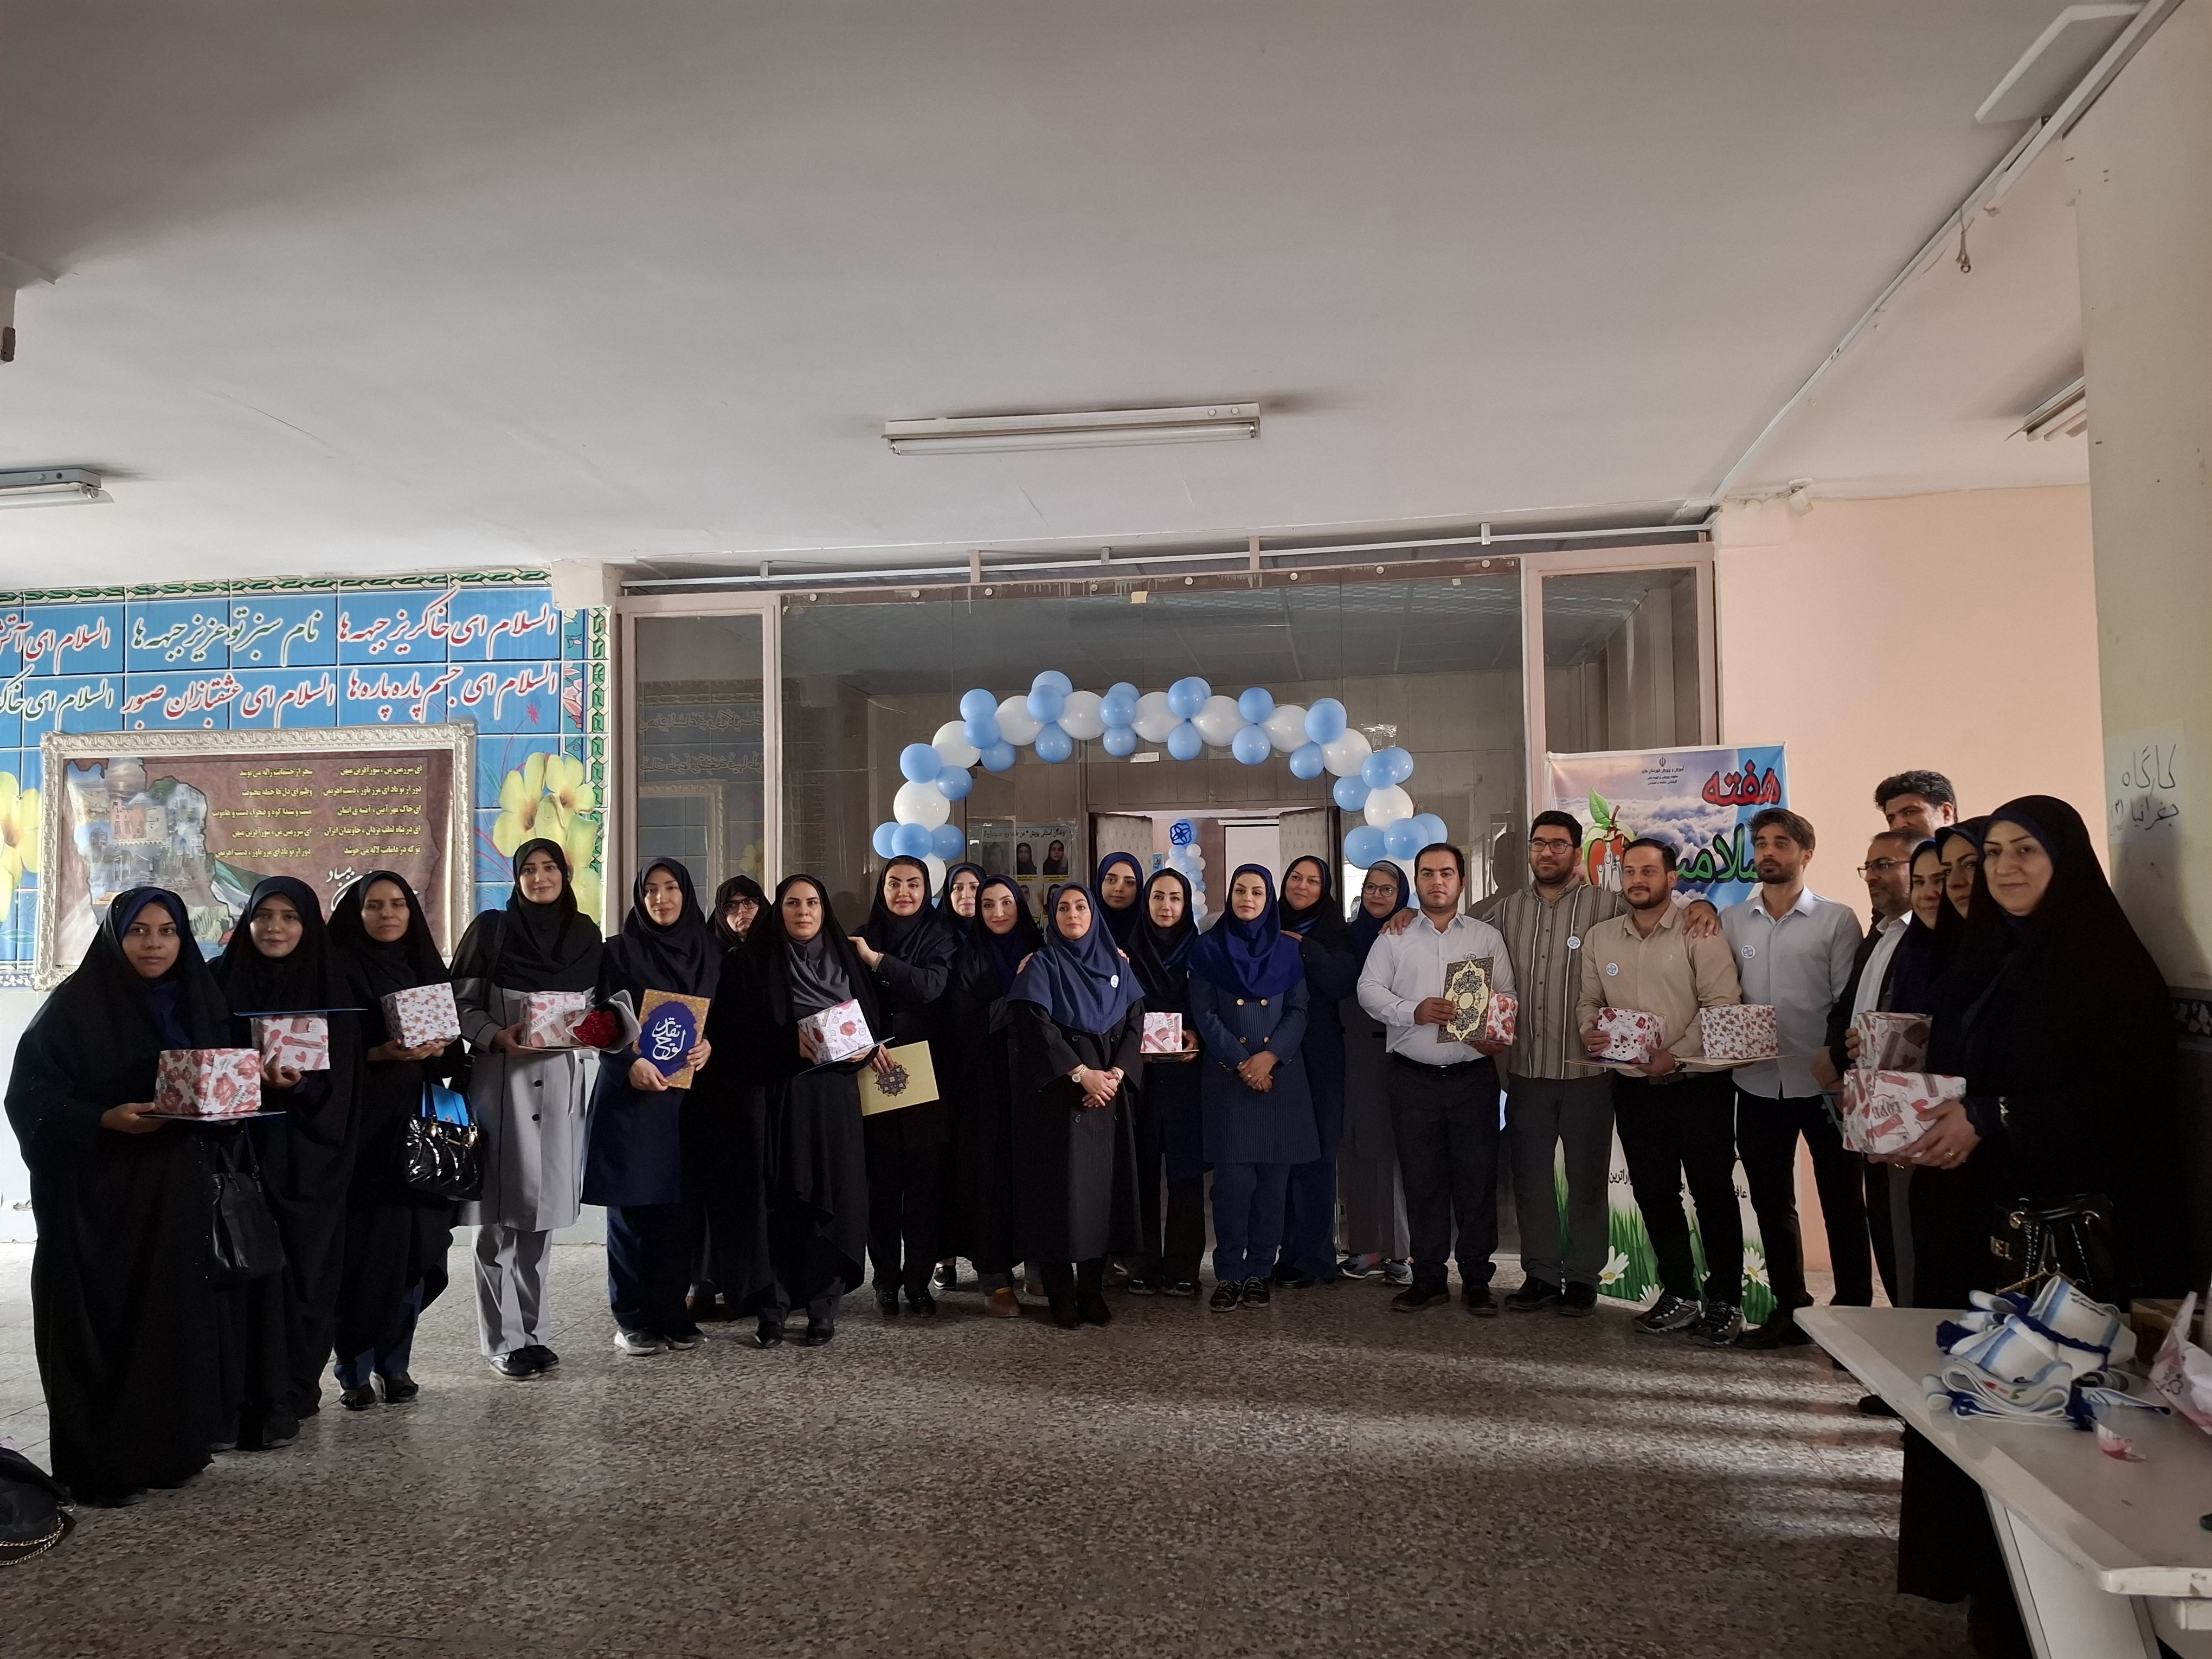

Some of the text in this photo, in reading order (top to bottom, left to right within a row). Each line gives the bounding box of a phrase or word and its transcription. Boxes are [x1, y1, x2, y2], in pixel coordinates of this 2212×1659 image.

[186, 615, 229, 660] عزیز
[228, 608, 248, 644] تو
[235, 613, 281, 659] سبز
[283, 611, 321, 665] نام
[390, 587, 459, 653] خاکریز
[450, 619, 486, 645] ای
[488, 605, 555, 659] السلام
[25, 631, 54, 659] ای
[56, 618, 109, 674] السلام
[25, 691, 56, 718] ای
[57, 680, 112, 730] السلام
[123, 686, 165, 729] صبور
[242, 686, 274, 715] ای
[276, 673, 335, 728] السلام
[421, 666, 461, 722] جسم
[463, 675, 494, 703] ای
[496, 663, 557, 719] السلام
[1701, 759, 1782, 807] هفته
